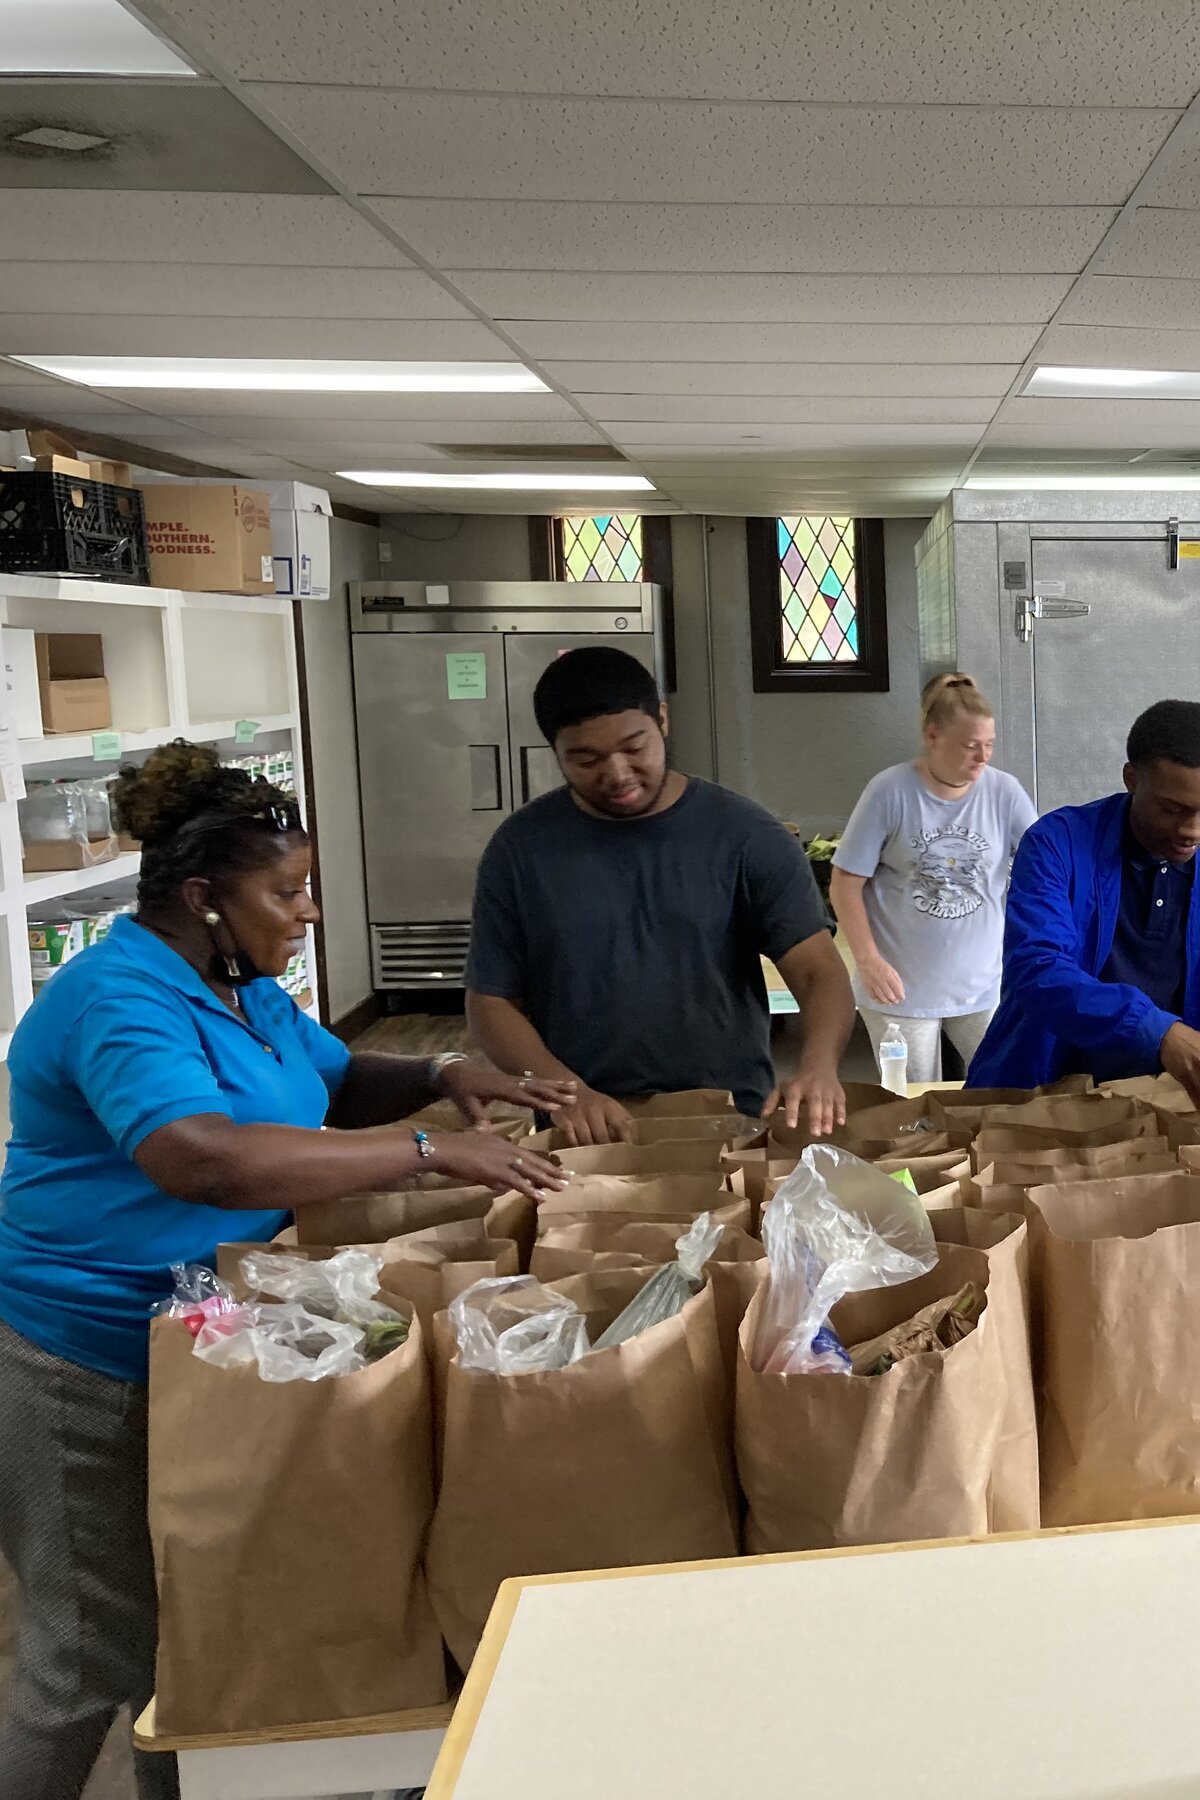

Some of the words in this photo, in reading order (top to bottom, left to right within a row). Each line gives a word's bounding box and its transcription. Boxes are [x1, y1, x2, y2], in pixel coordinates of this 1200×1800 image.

[146, 522, 189, 532] MPLE.
[147, 533, 215, 543] UTHERN.
[147, 545, 216, 554] OODNESS.
[911, 828, 941, 855] You
